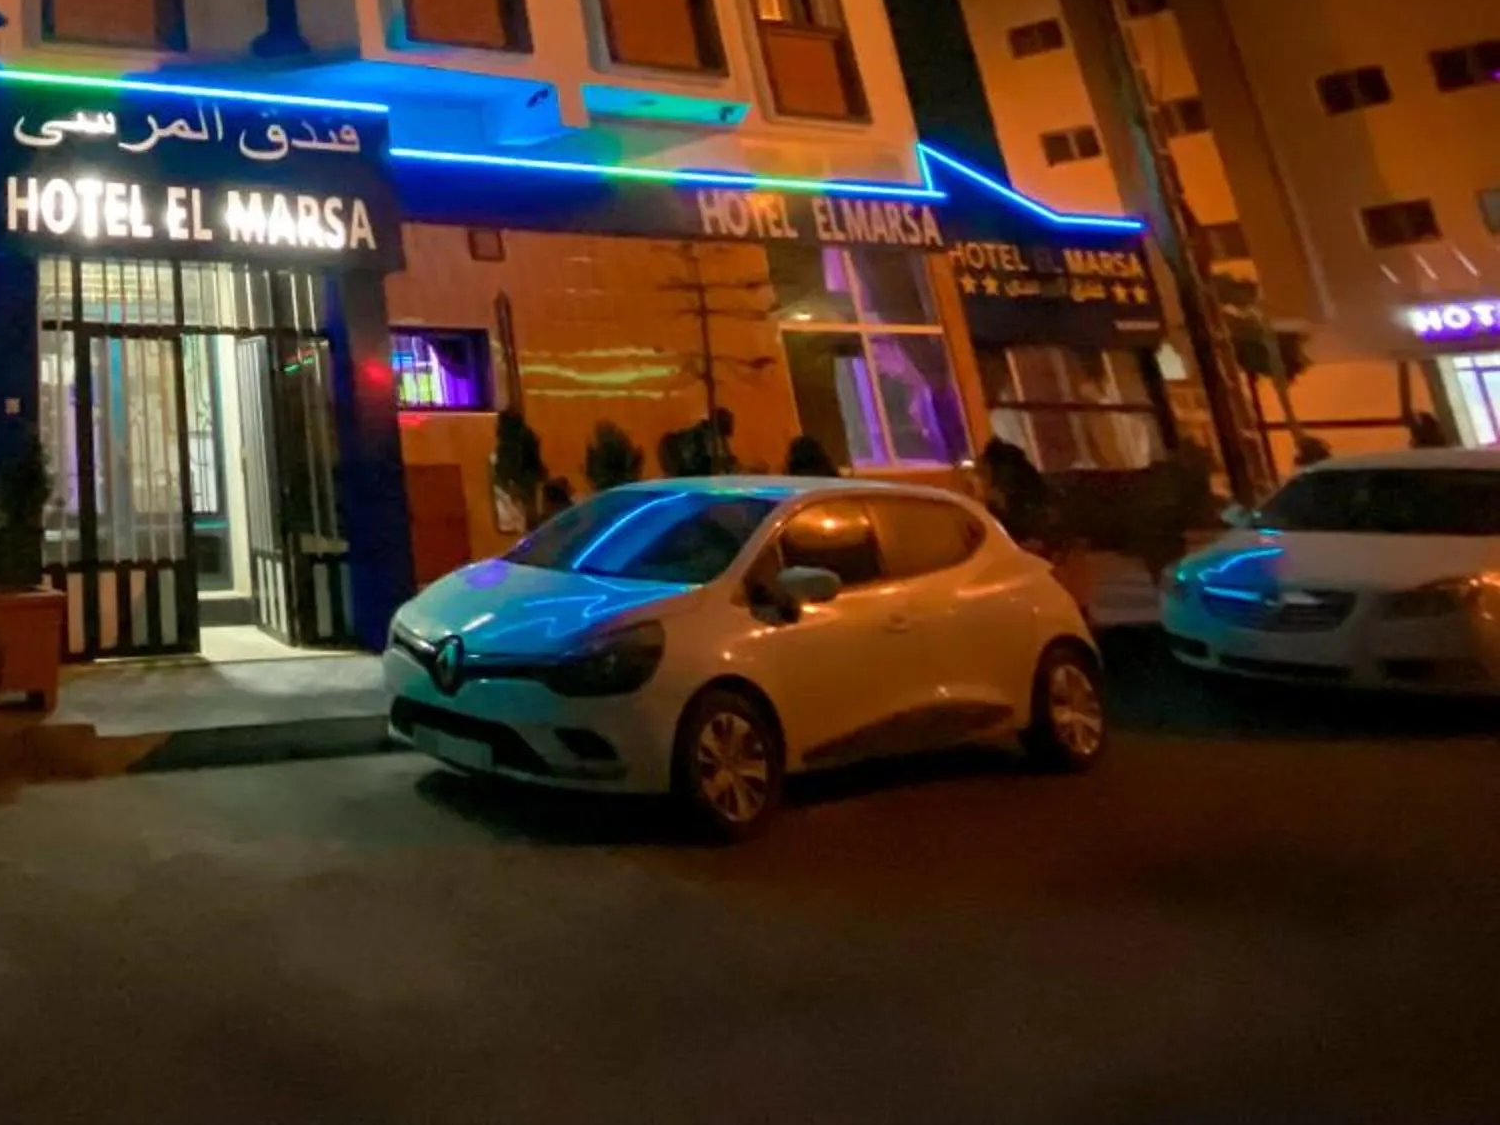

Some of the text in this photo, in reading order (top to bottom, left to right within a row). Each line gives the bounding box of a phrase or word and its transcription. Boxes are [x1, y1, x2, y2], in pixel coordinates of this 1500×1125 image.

[239, 106, 361, 161] فندق
[6, 175, 377, 251] HOTEL EL MARSA
[696, 189, 799, 238] HOTEL
[949, 241, 1029, 272] HOTEL
[1063, 248, 1145, 278] MARSA
